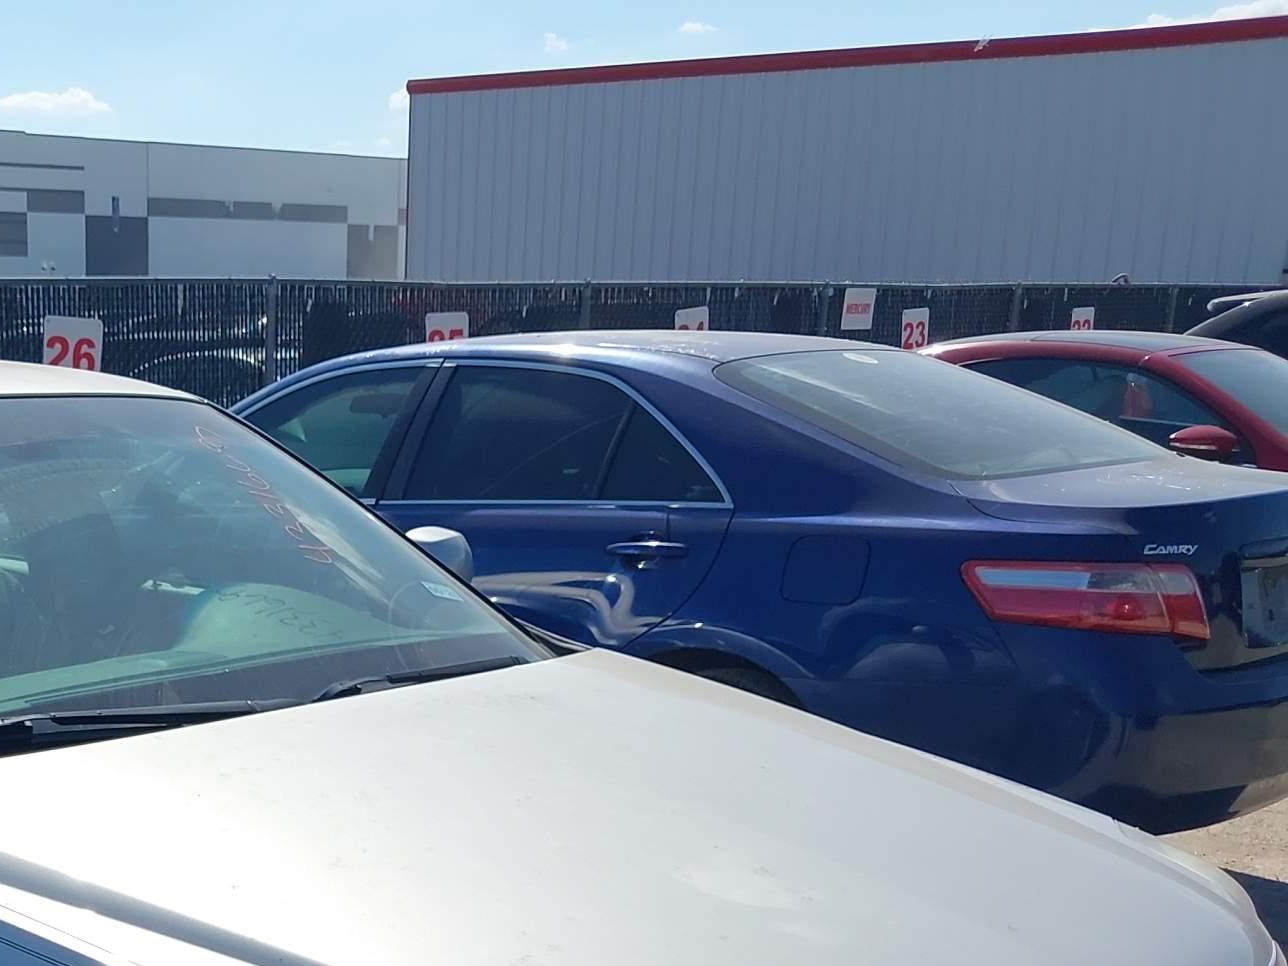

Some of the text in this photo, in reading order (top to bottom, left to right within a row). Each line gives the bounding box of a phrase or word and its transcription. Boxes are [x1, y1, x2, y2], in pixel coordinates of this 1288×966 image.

[903, 321, 926, 349] 23
[46, 335, 96, 370] 26
[1143, 544, 1199, 556] CAMRY
